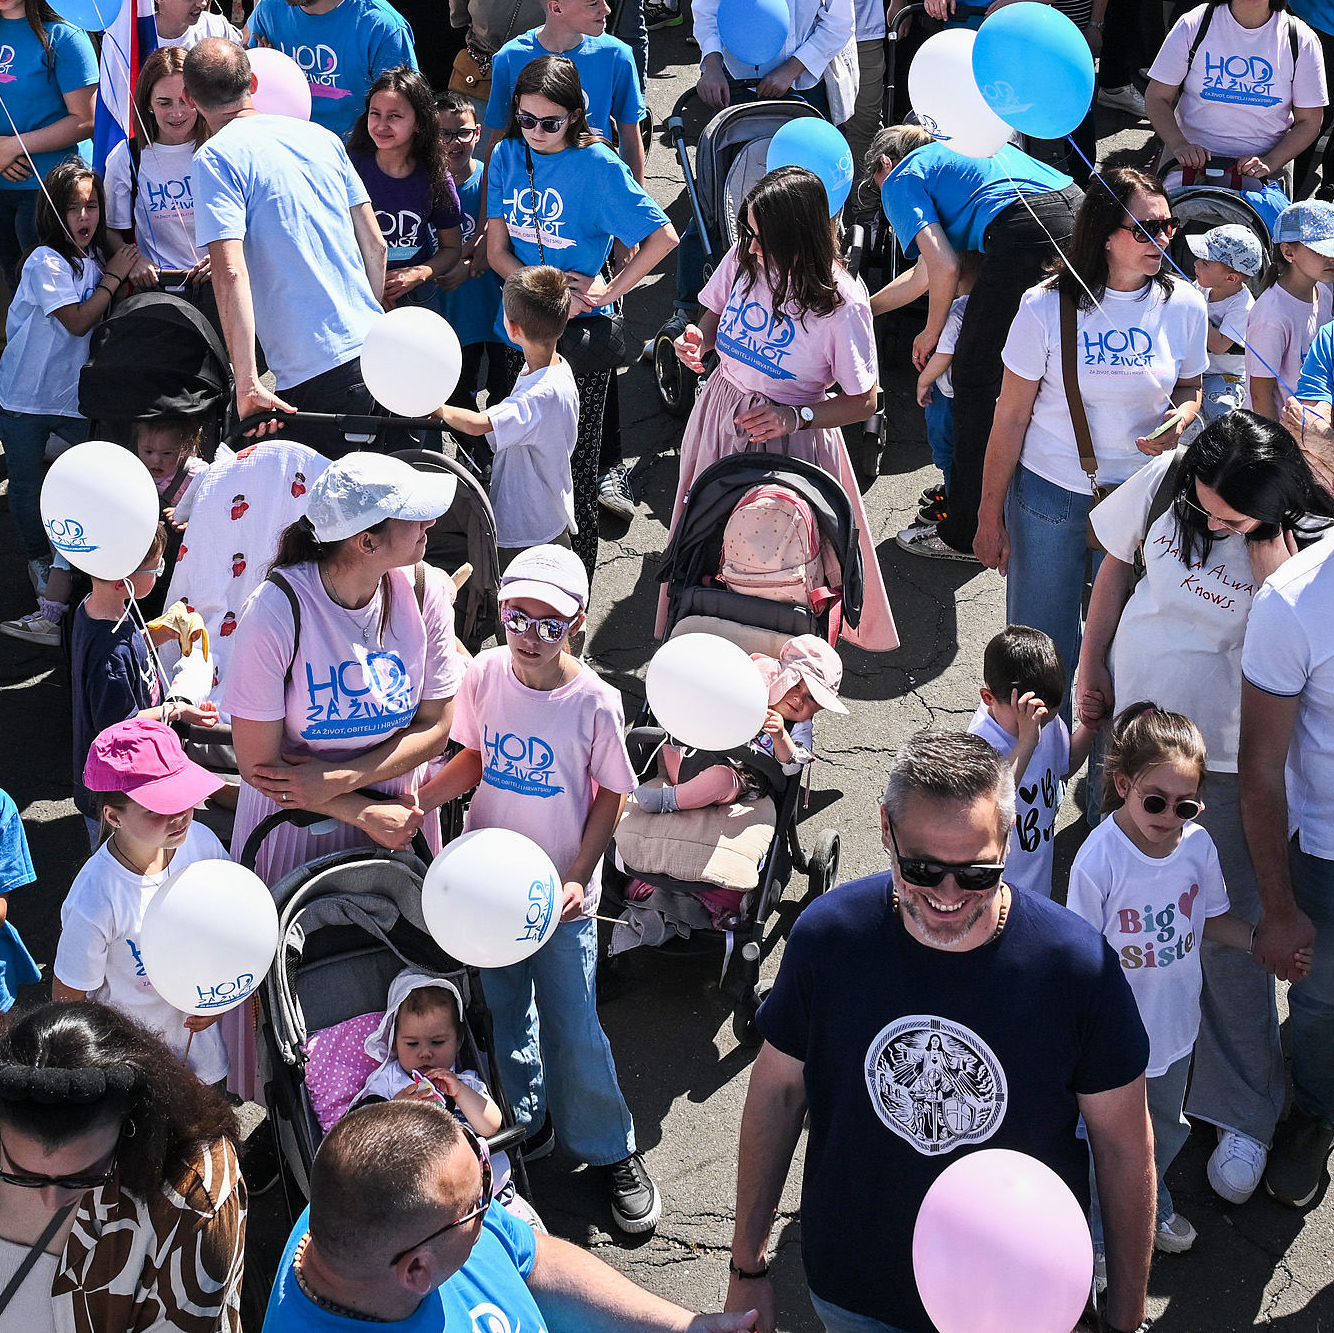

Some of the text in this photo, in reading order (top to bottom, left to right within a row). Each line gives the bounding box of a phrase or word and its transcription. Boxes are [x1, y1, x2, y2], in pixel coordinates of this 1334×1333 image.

[1083, 327, 1151, 359] HOD
[305, 651, 407, 707] HOD
[306, 687, 414, 721] ZA ŽIVOT
[1118, 903, 1175, 941] Big
